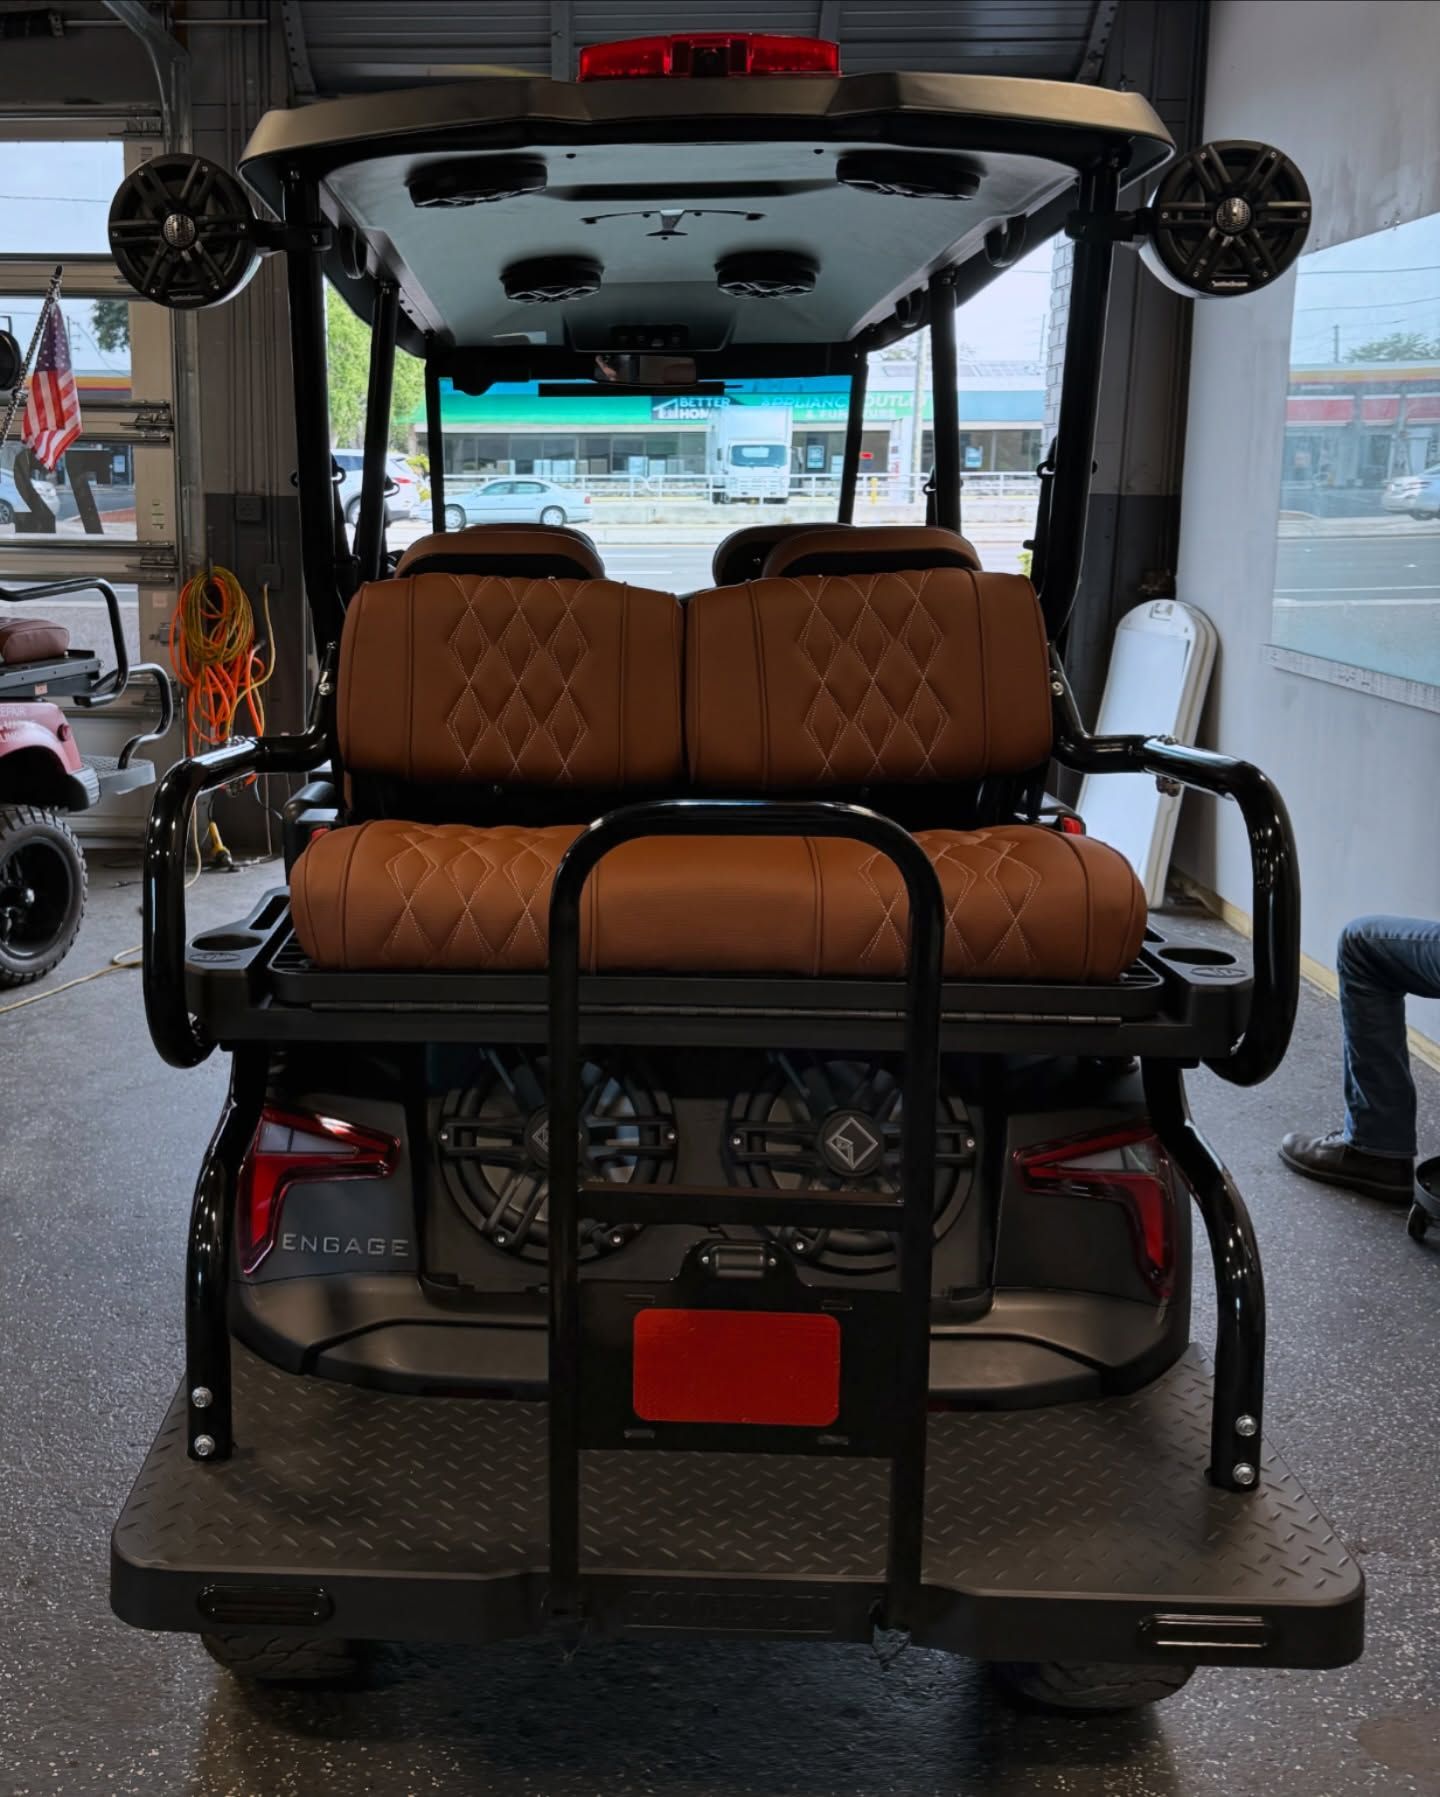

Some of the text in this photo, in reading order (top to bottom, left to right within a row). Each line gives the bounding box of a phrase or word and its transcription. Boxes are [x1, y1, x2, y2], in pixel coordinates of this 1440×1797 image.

[680, 397, 731, 407] BETTER
[761, 393, 928, 408] APPLIANC OUTLT
[282, 1234, 409, 1257] ENGAGE
